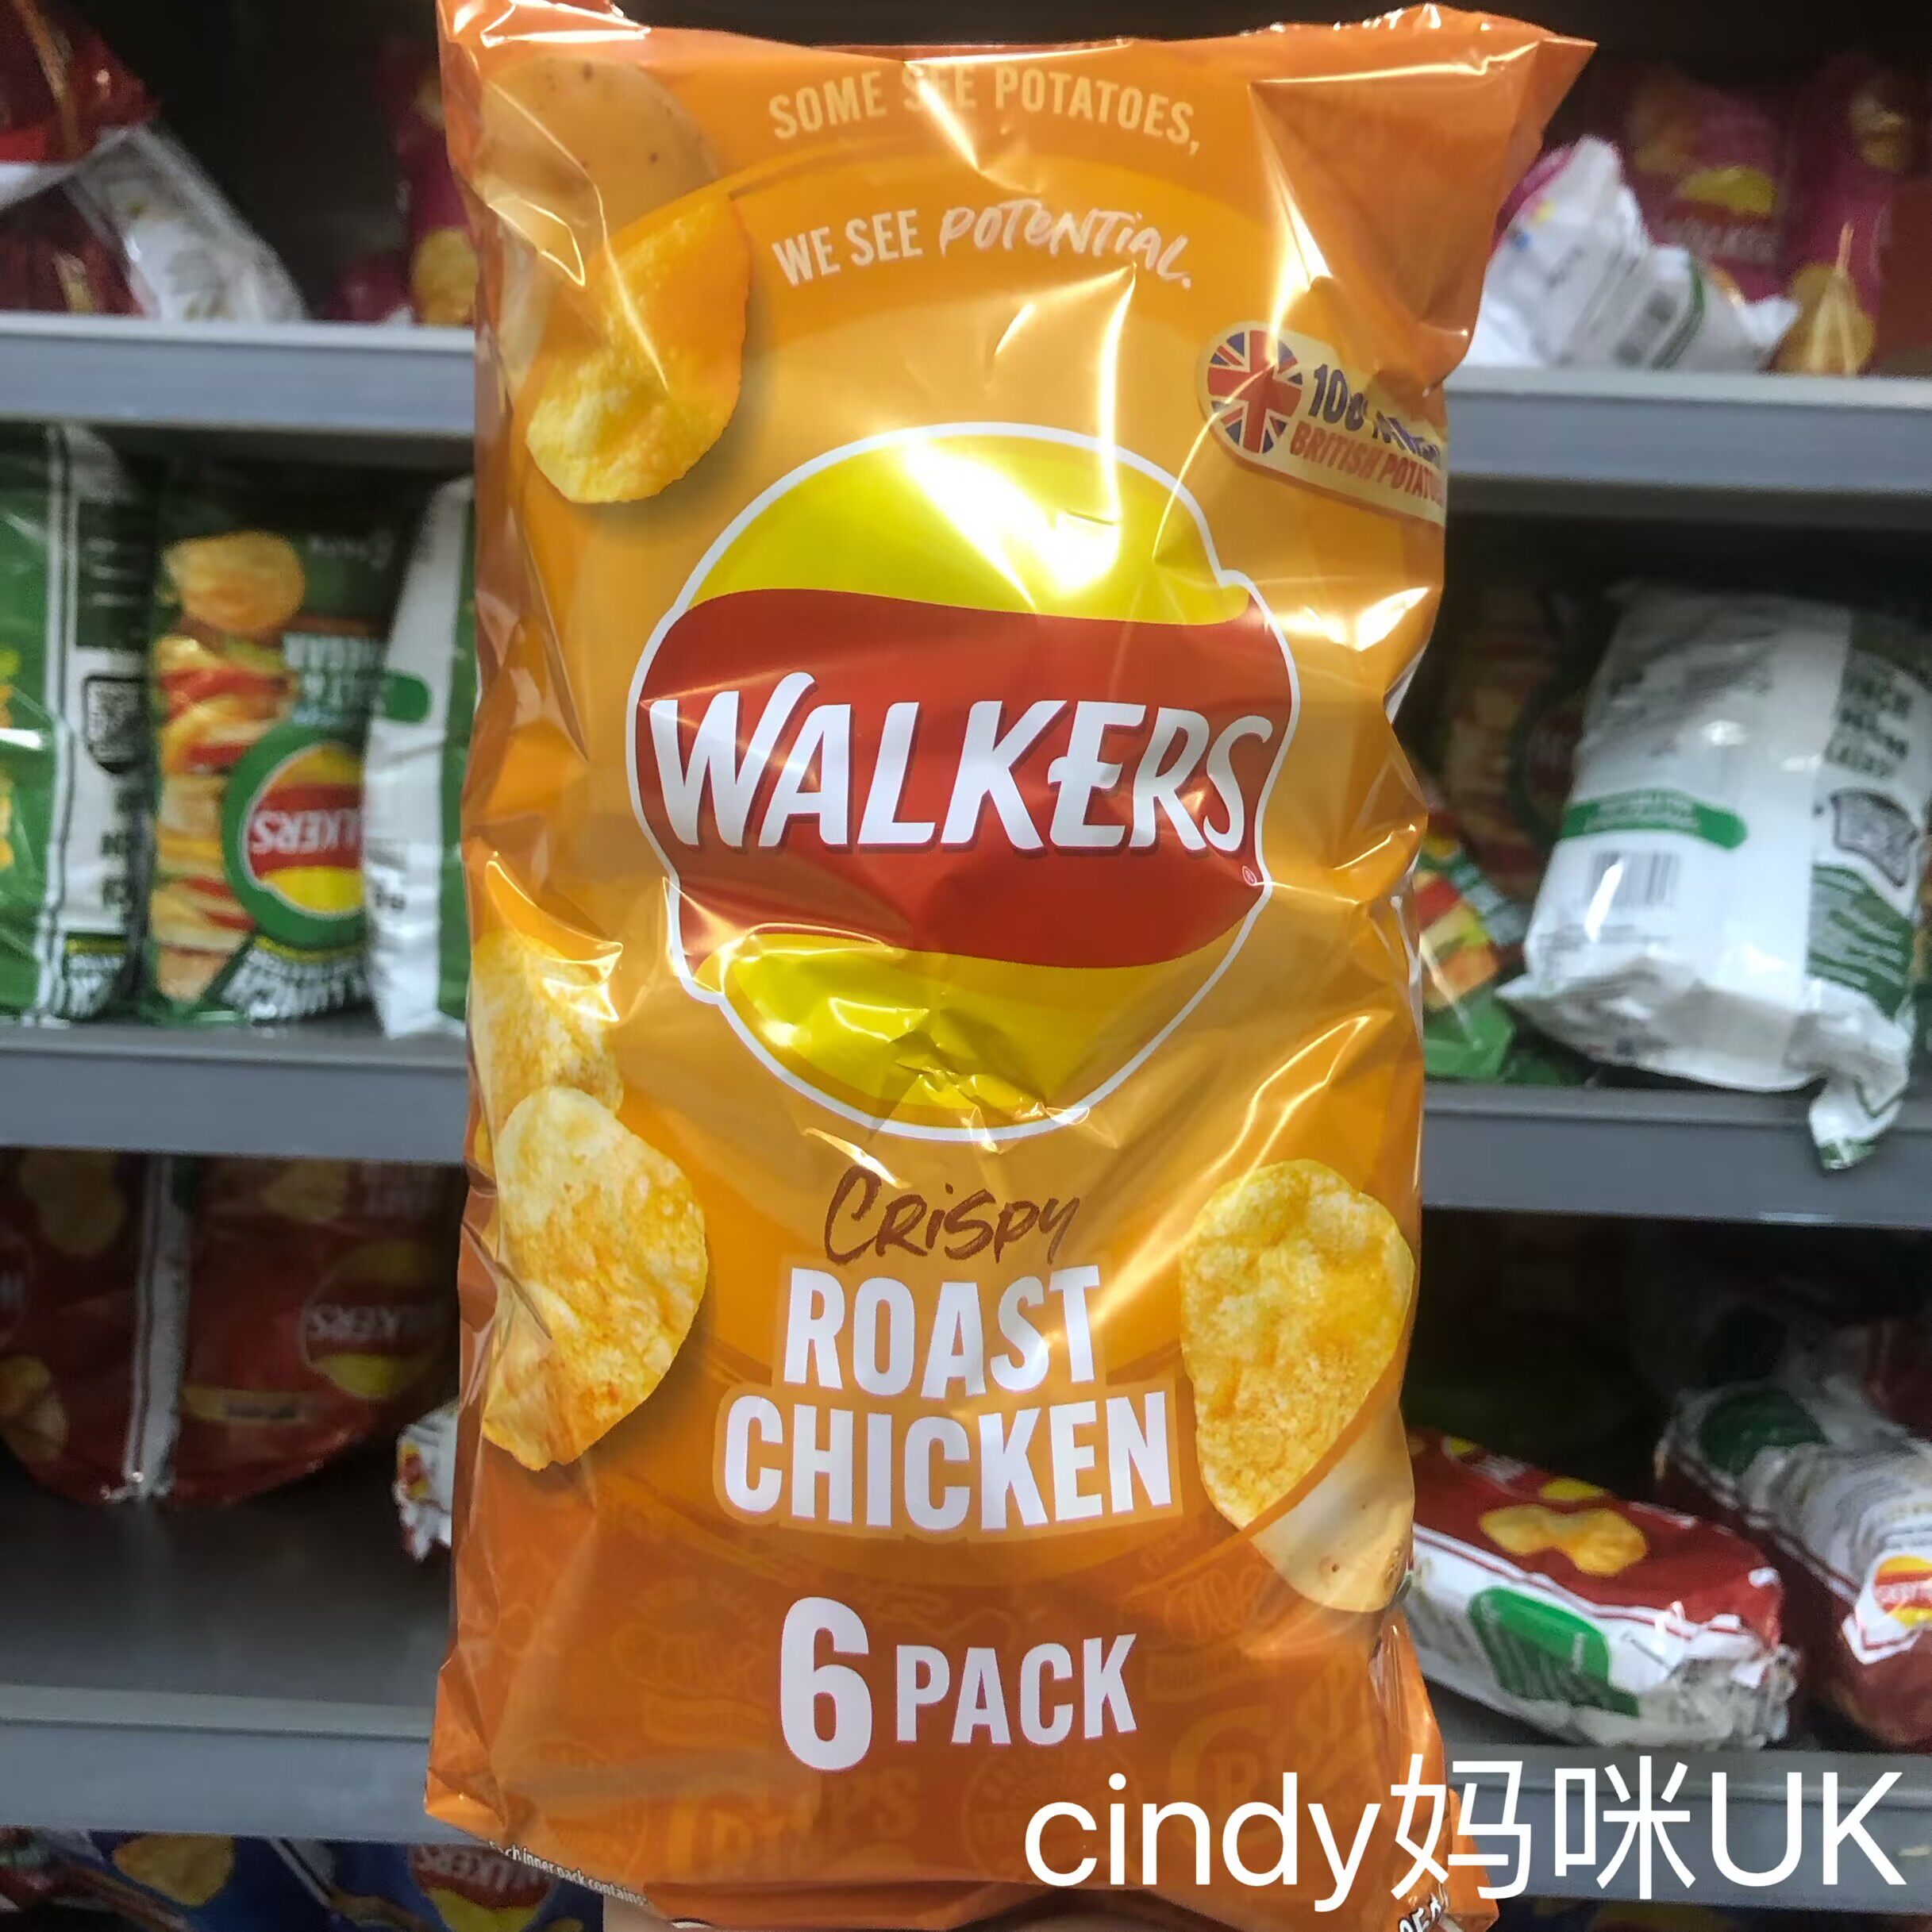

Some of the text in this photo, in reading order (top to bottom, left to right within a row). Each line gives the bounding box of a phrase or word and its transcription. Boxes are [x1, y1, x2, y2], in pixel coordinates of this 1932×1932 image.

[768, 69, 887, 139] SOME
[995, 67, 1199, 156] POTATOES,
[772, 226, 840, 287] WE
[845, 209, 923, 266] SEE
[1290, 420, 1384, 481] BRITISH
[649, 672, 1273, 852] WALKERS
[783, 1264, 1100, 1399] ROAST
[724, 1391, 1172, 1530] CHICKEN
[780, 1596, 1138, 1771] 6 PACK
[523, 1847, 555, 1874] inner
